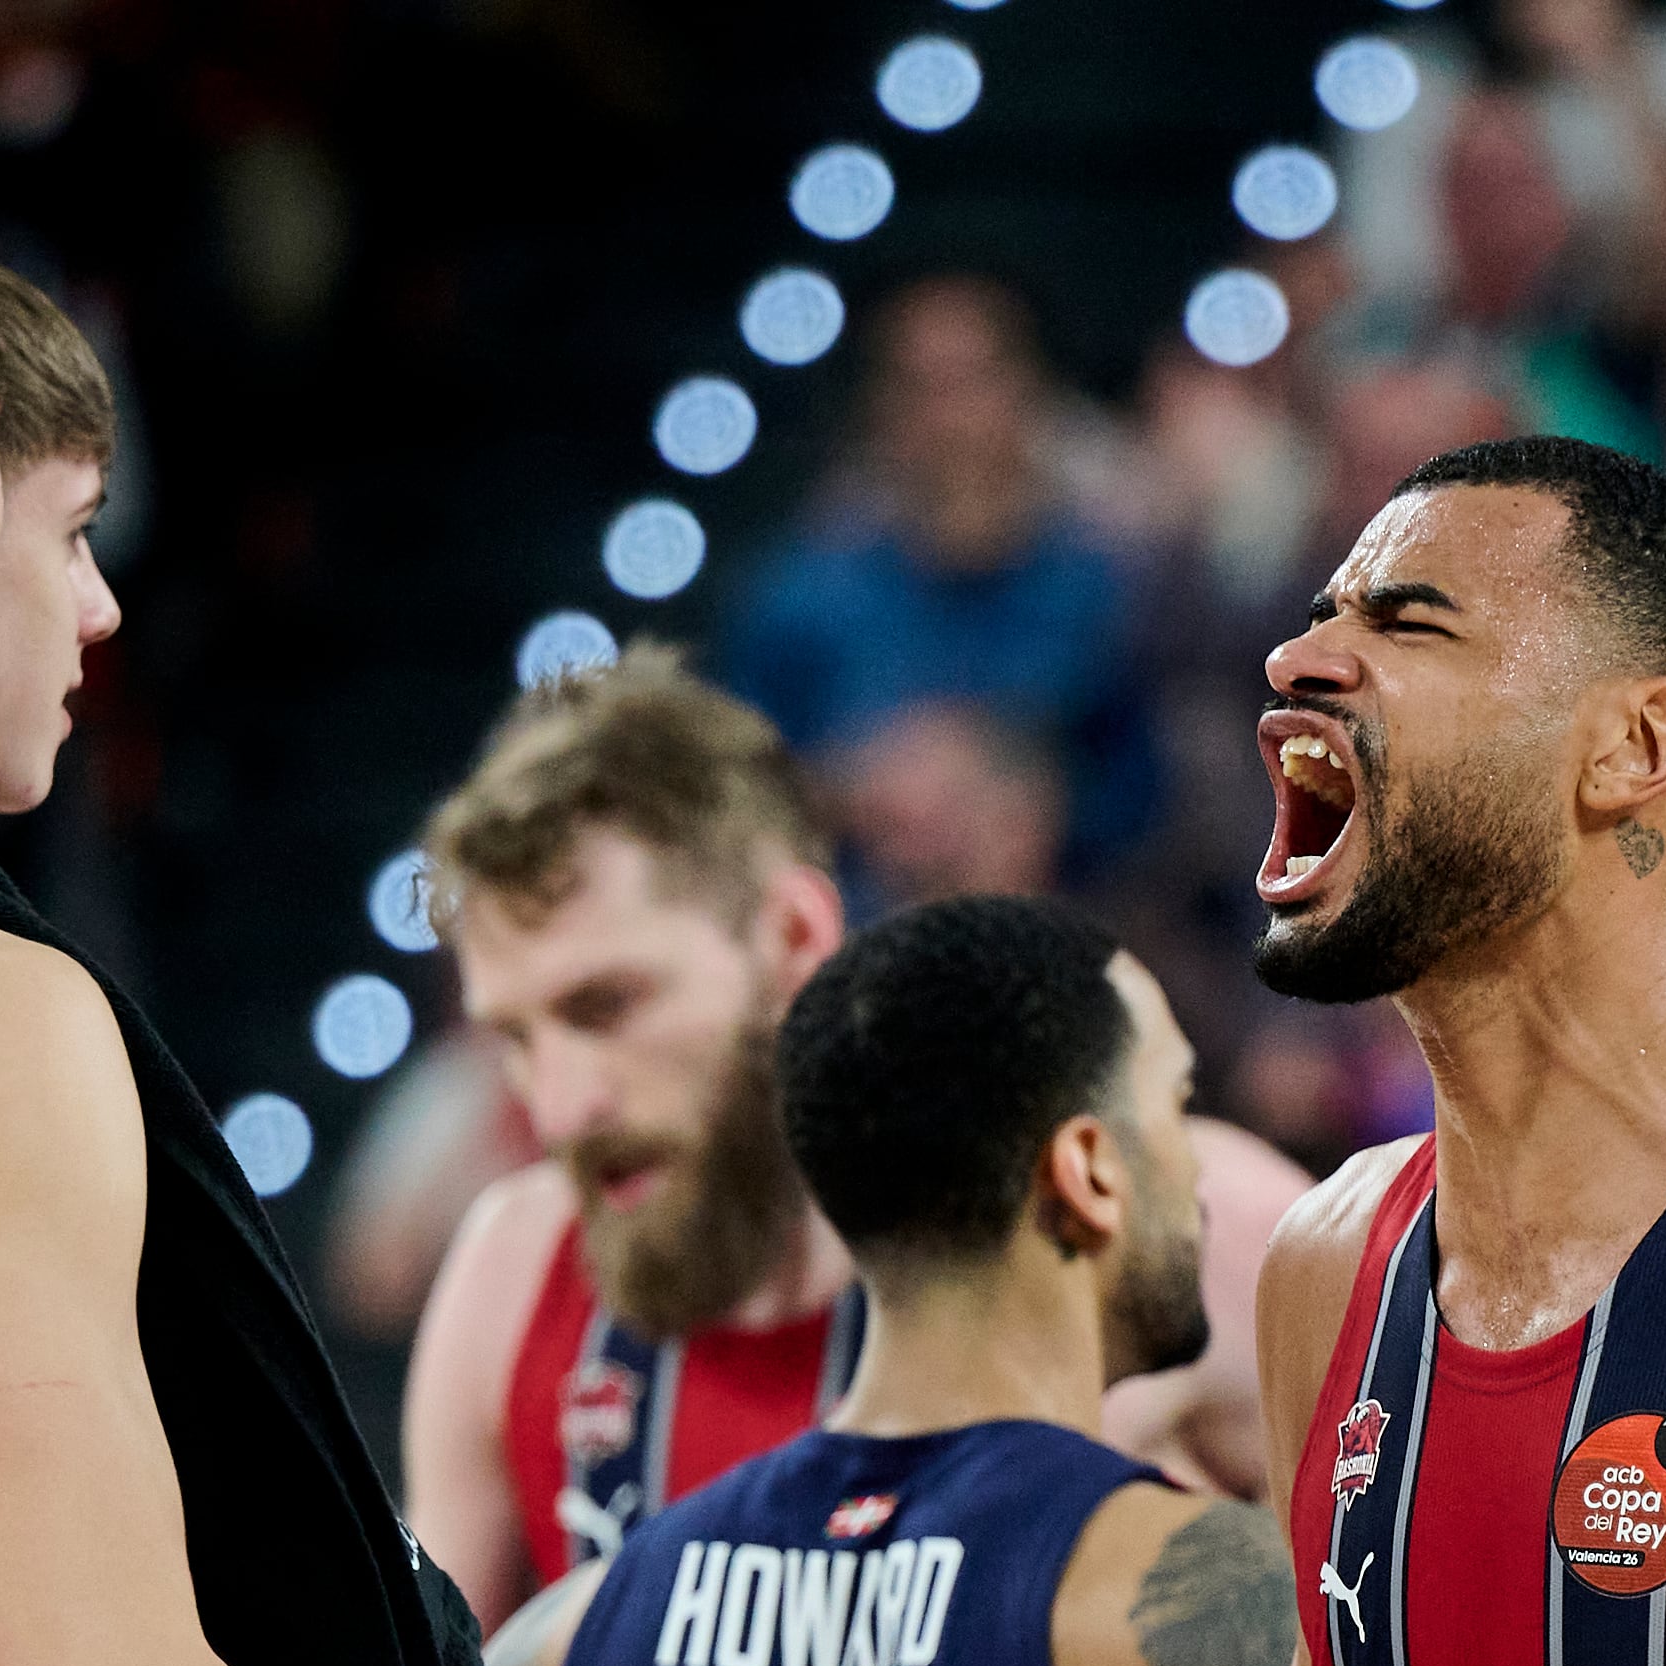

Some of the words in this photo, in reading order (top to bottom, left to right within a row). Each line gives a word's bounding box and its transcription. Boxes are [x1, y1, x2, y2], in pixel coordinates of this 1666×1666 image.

[1603, 1465, 1644, 1485] acb
[1583, 1482, 1662, 1515] Copa
[1584, 1514, 1613, 1531] del
[1568, 1549, 1621, 1564] Valencia
